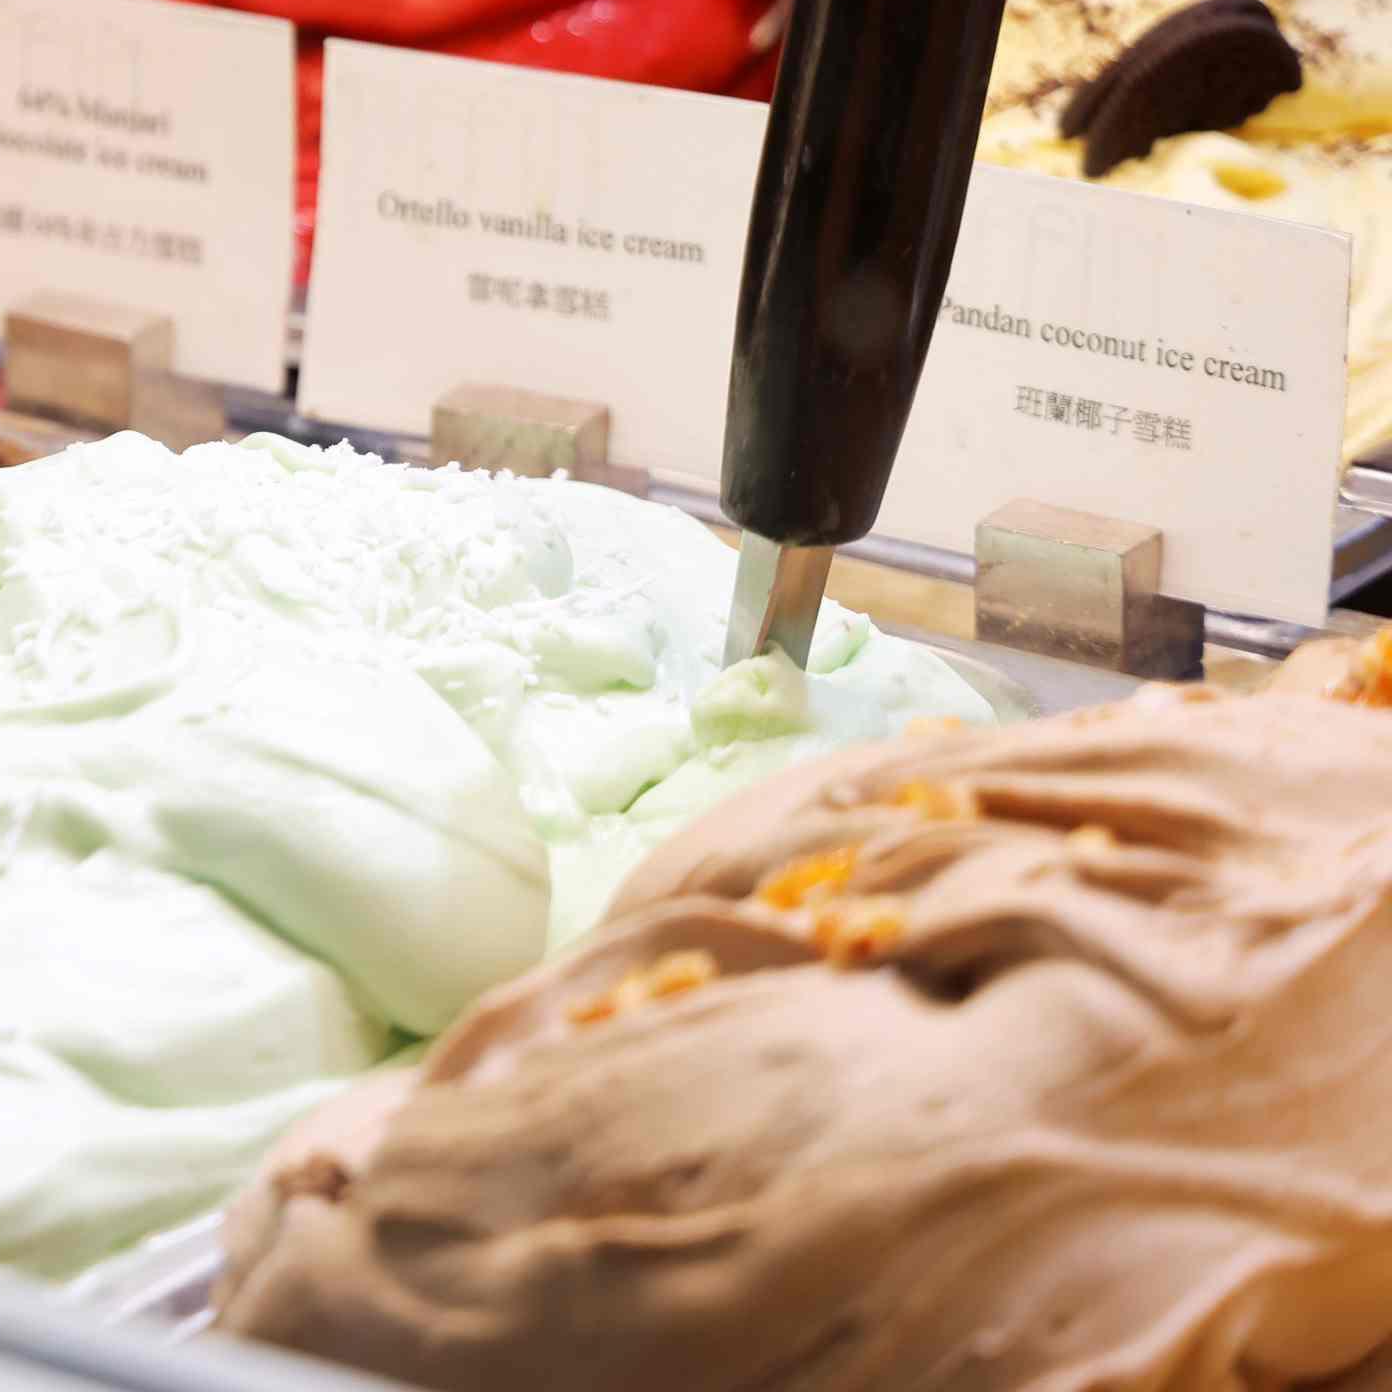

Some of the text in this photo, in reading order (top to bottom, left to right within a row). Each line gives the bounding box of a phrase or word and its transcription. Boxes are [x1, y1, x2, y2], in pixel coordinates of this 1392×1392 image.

[95, 141, 128, 170] ice
[136, 153, 209, 183] cream
[479, 208, 568, 246] vanilla
[576, 220, 614, 252] ice
[622, 234, 705, 264] cream
[1039, 317, 1147, 363] coconut
[1156, 337, 1195, 372] ice
[1202, 354, 1287, 392] cream
[1013, 384, 1193, 450] 班蘭椰子雪糕
